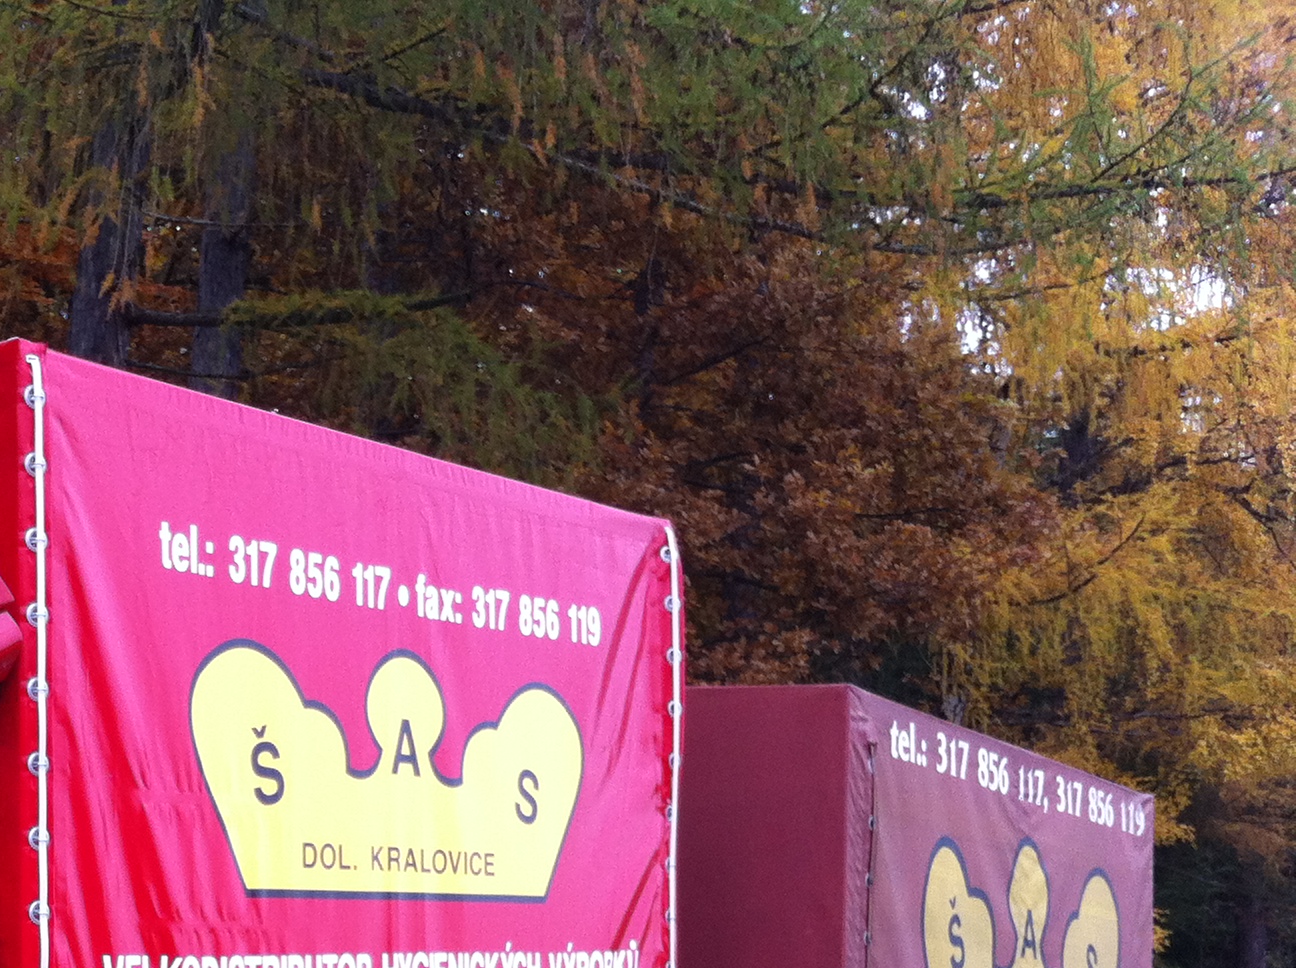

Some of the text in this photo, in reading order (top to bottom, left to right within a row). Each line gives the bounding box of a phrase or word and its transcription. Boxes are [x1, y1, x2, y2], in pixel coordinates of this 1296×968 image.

[158, 521, 602, 647] tel.: 317 856 117 fax: 317 856 119
[890, 720, 1146, 837] tel.: 317 856 117, 317 856 119
[302, 842, 496, 877] DOL. KRALOVICE
